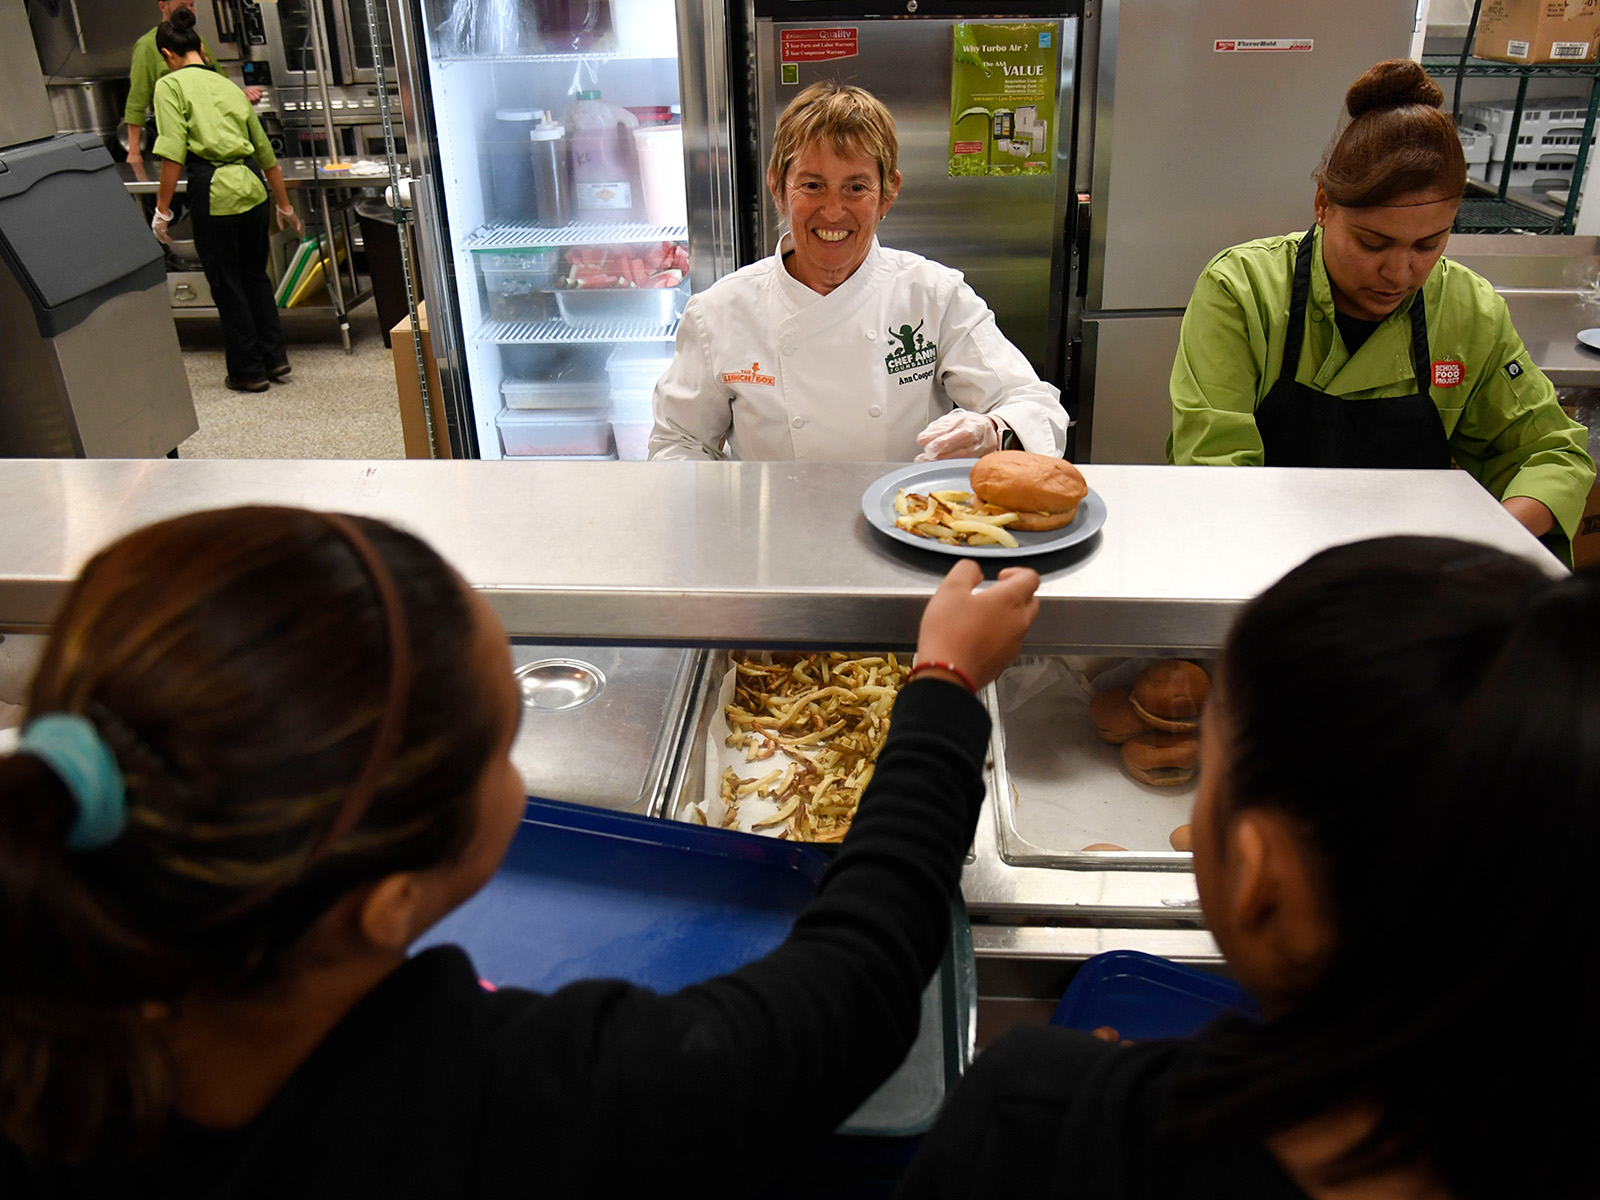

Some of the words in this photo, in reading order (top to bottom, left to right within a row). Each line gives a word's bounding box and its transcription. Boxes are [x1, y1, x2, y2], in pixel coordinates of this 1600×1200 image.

[819, 30, 851, 39] Quality
[962, 45, 980, 53] Why
[981, 44, 1007, 52] Turbo
[1009, 44, 1022, 52] Air
[1024, 44, 1029, 52] ?
[1003, 65, 1044, 76] VALUE
[888, 354, 914, 368] CHEF
[915, 347, 936, 361] ANN
[890, 357, 937, 373] FOUNDATION
[1435, 364, 1460, 372] SCHOOL
[724, 374, 751, 382] LUNCH
[755, 376, 773, 384] BOX
[898, 376, 914, 385] Ann
[912, 369, 934, 382] Cooper
